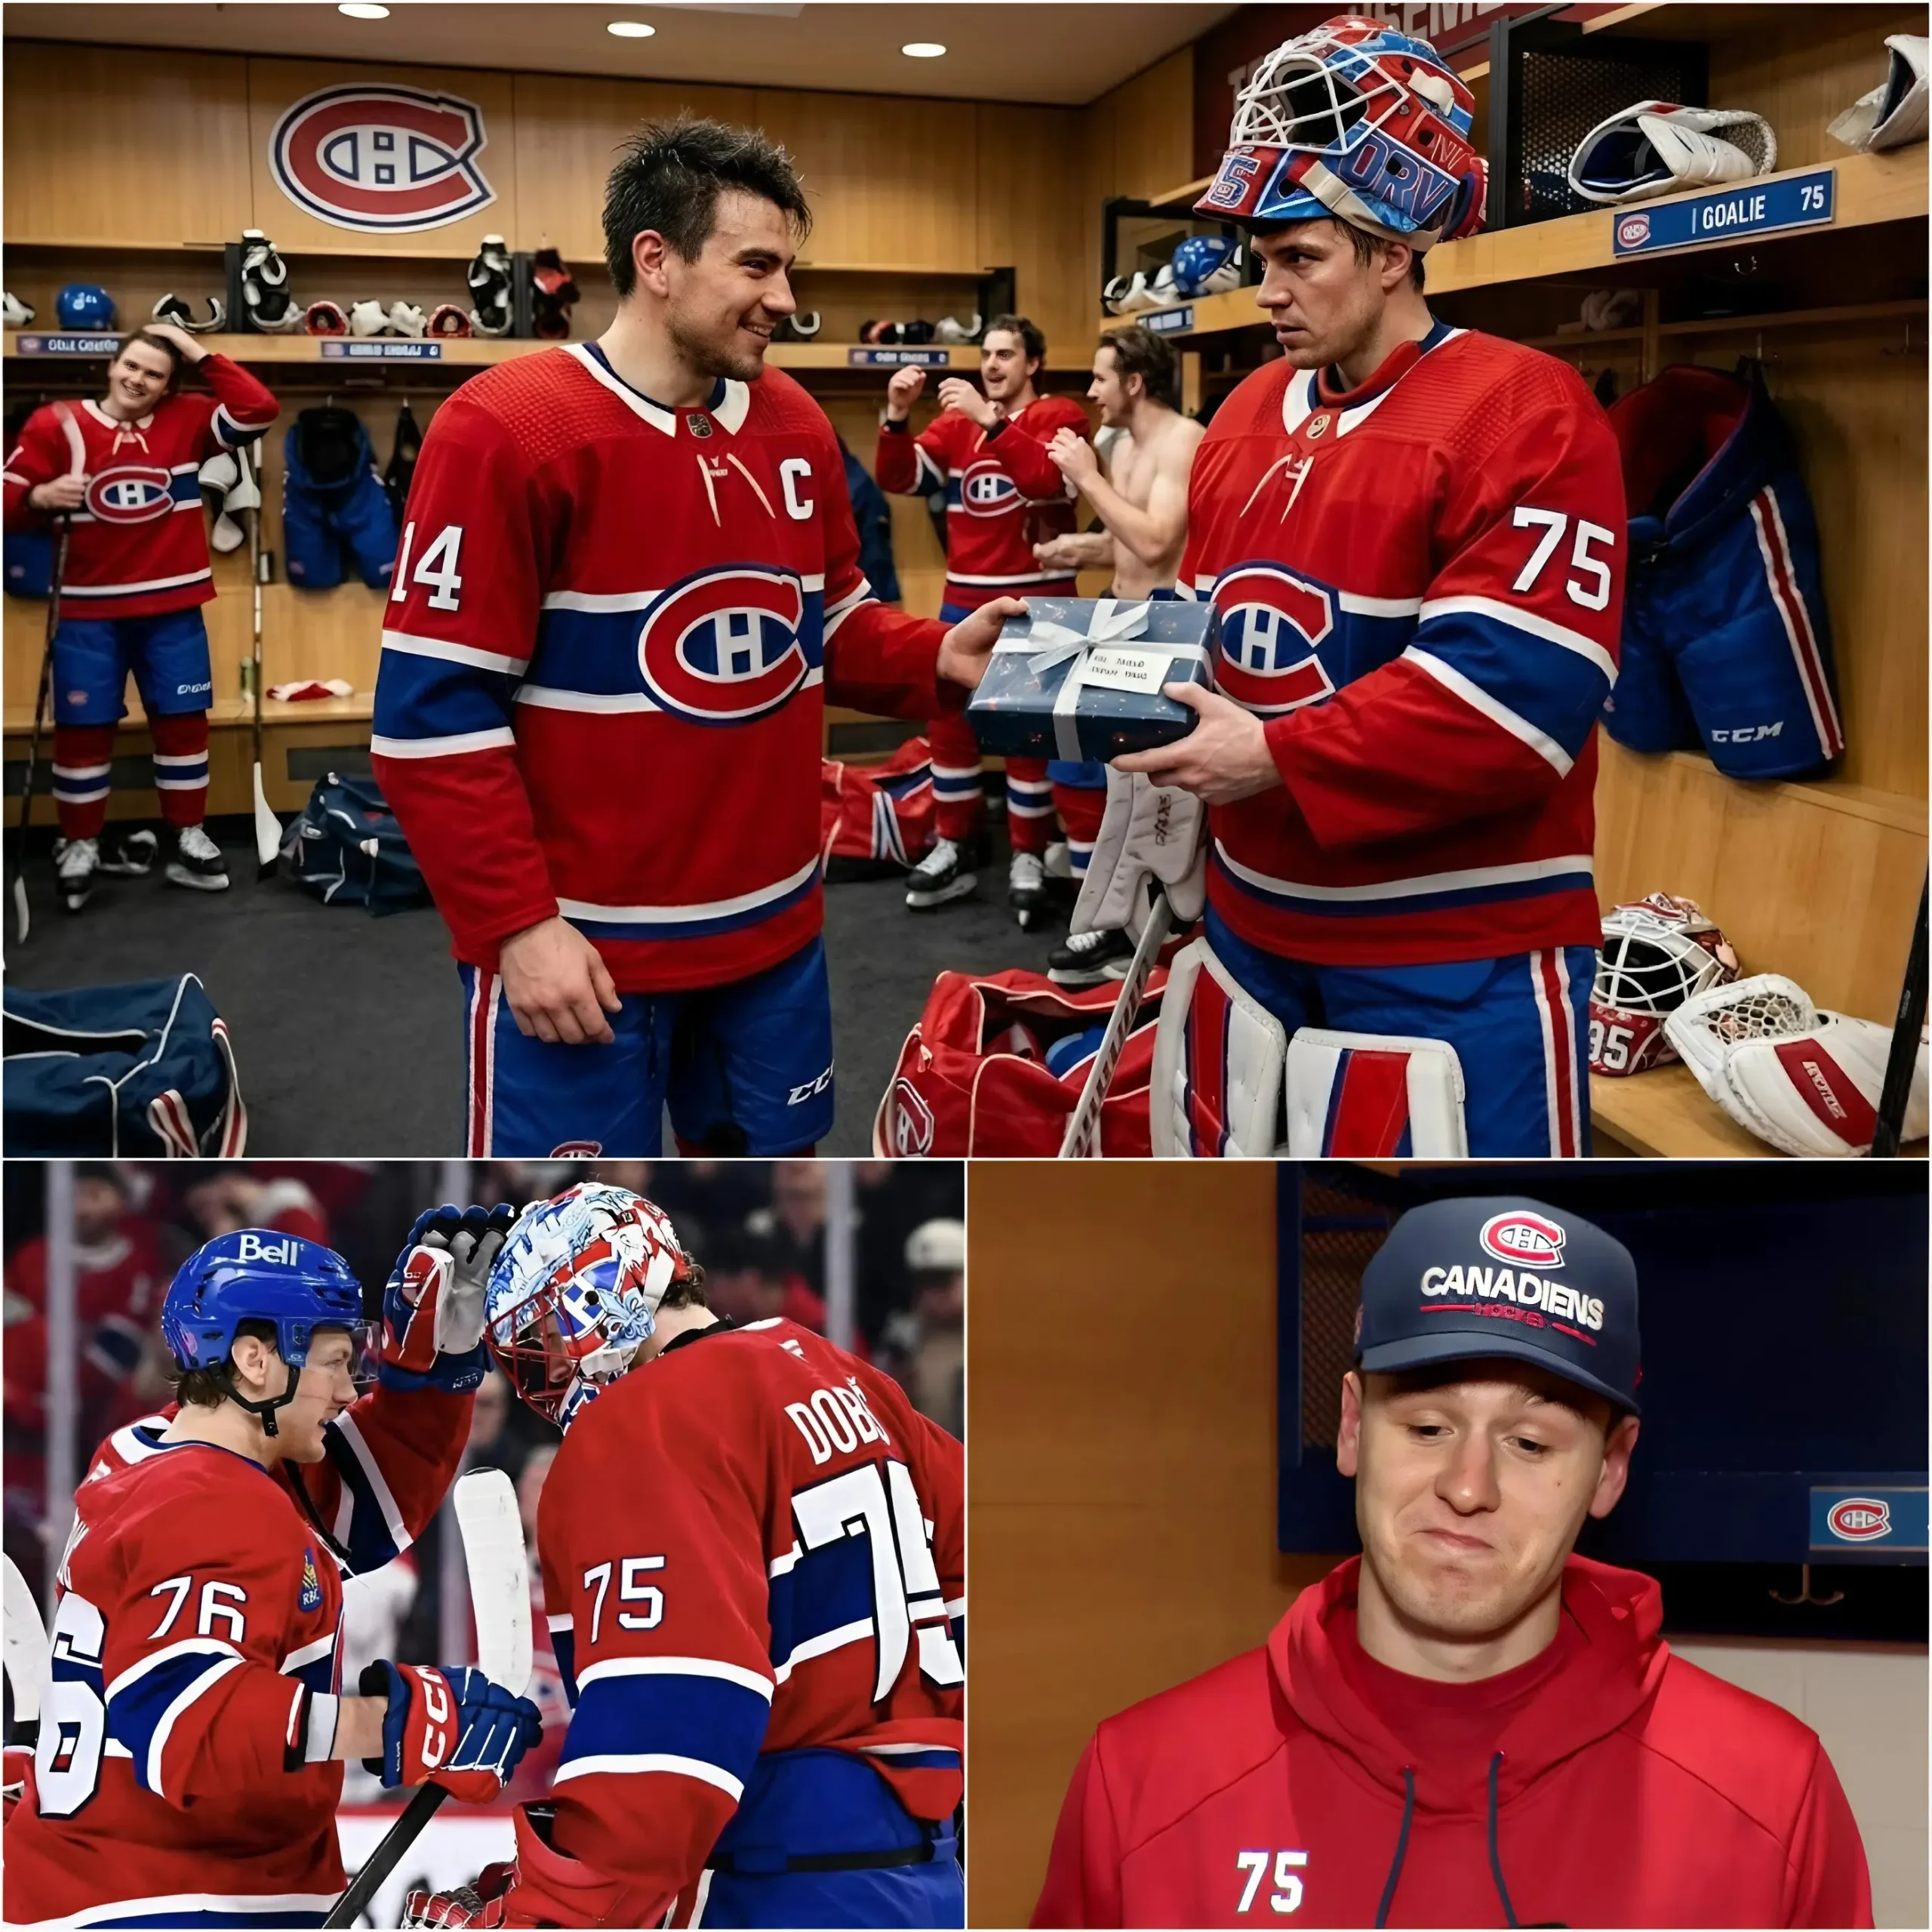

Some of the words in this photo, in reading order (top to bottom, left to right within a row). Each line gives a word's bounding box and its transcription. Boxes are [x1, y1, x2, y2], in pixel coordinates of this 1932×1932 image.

[1703, 195, 1766, 230] GOALIE
[1801, 184, 1825, 211] 75
[780, 458, 814, 521] C
[390, 521, 465, 612] 14
[1512, 505, 1615, 612] 75
[1711, 721, 1784, 743] CCM
[786, 1058, 835, 1106] CC
[239, 1234, 298, 1267] Bell
[1420, 1265, 1605, 1331] CANADIENS
[147, 1575, 246, 1643] 76
[583, 1555, 666, 1644] 75
[1236, 1851, 1309, 1913] 75
